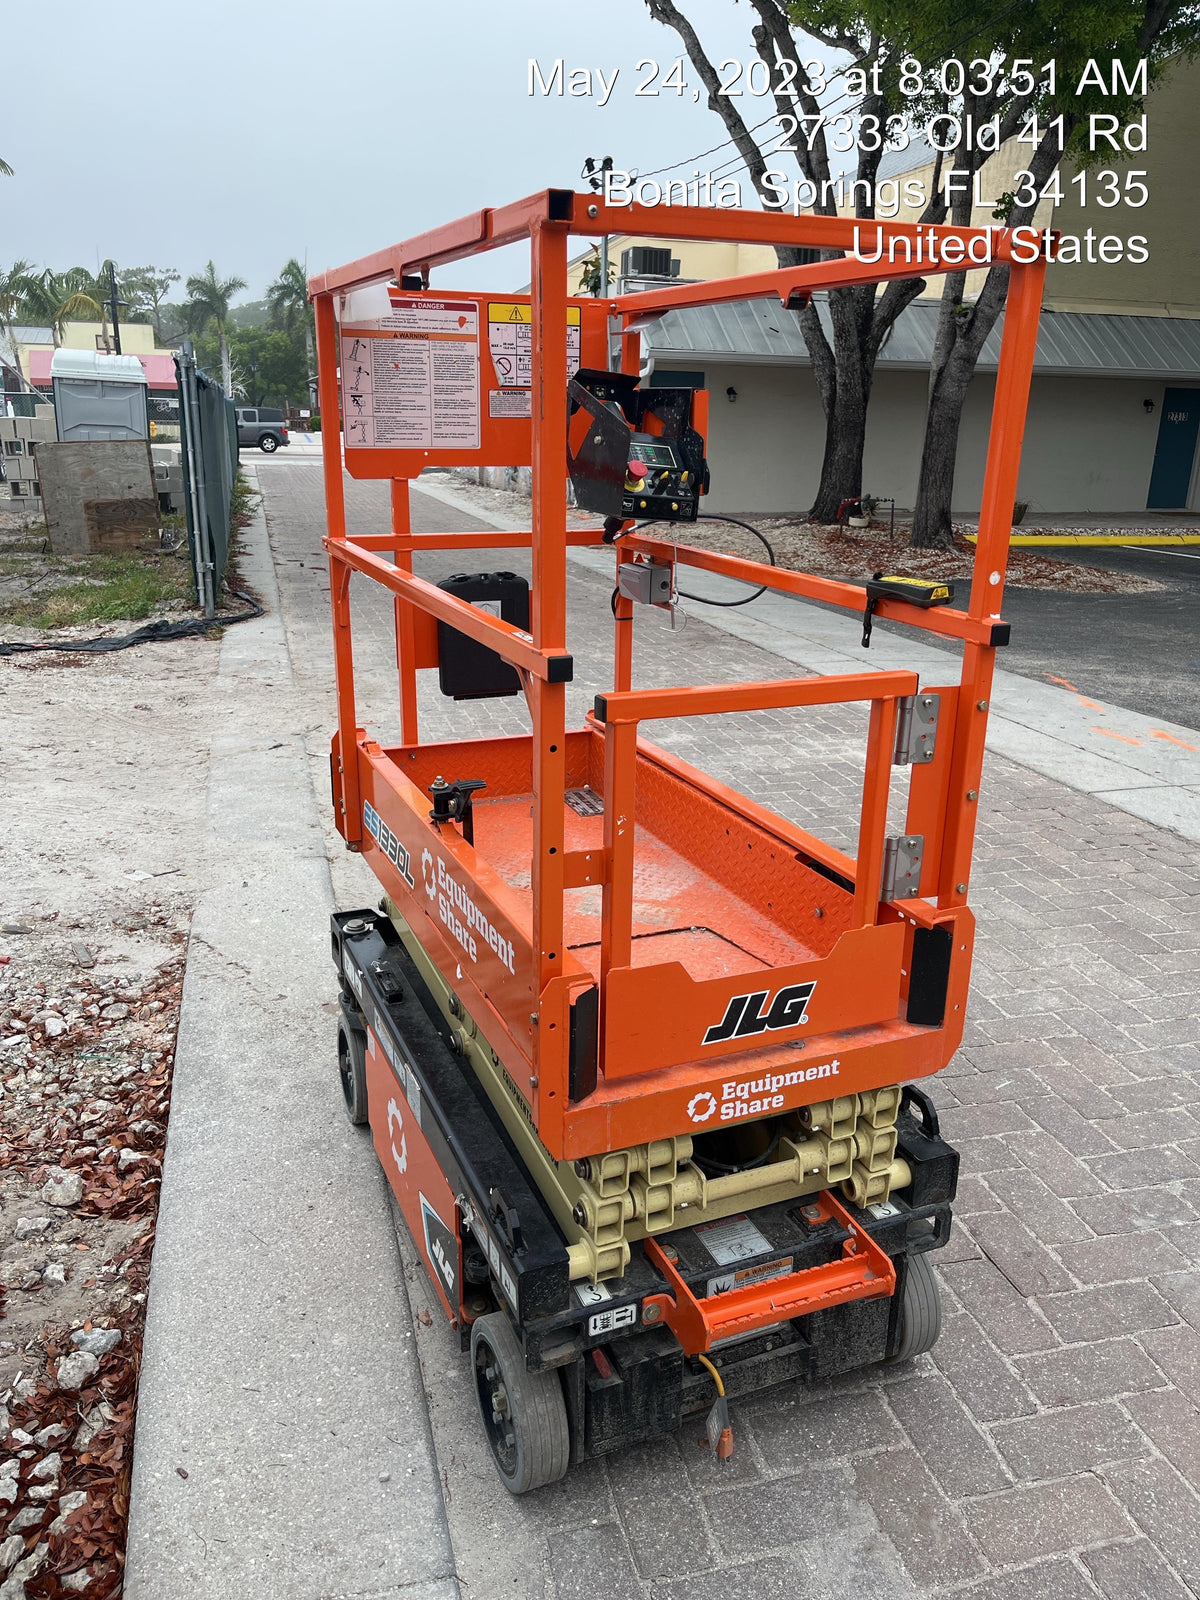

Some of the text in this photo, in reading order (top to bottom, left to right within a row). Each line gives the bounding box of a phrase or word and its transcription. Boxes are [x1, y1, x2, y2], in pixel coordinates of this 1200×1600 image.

[417, 302, 445, 310] DANGER
[399, 332, 430, 340] WARNING
[364, 799, 415, 889] ES1330L
[436, 855, 516, 976] Equipment
[438, 892, 478, 964] Share
[701, 981, 817, 1046] JLG
[721, 1059, 841, 1100] Equipment
[720, 1094, 785, 1121] Share
[431, 1238, 455, 1290] JLG
[751, 1261, 784, 1275] WARNING
